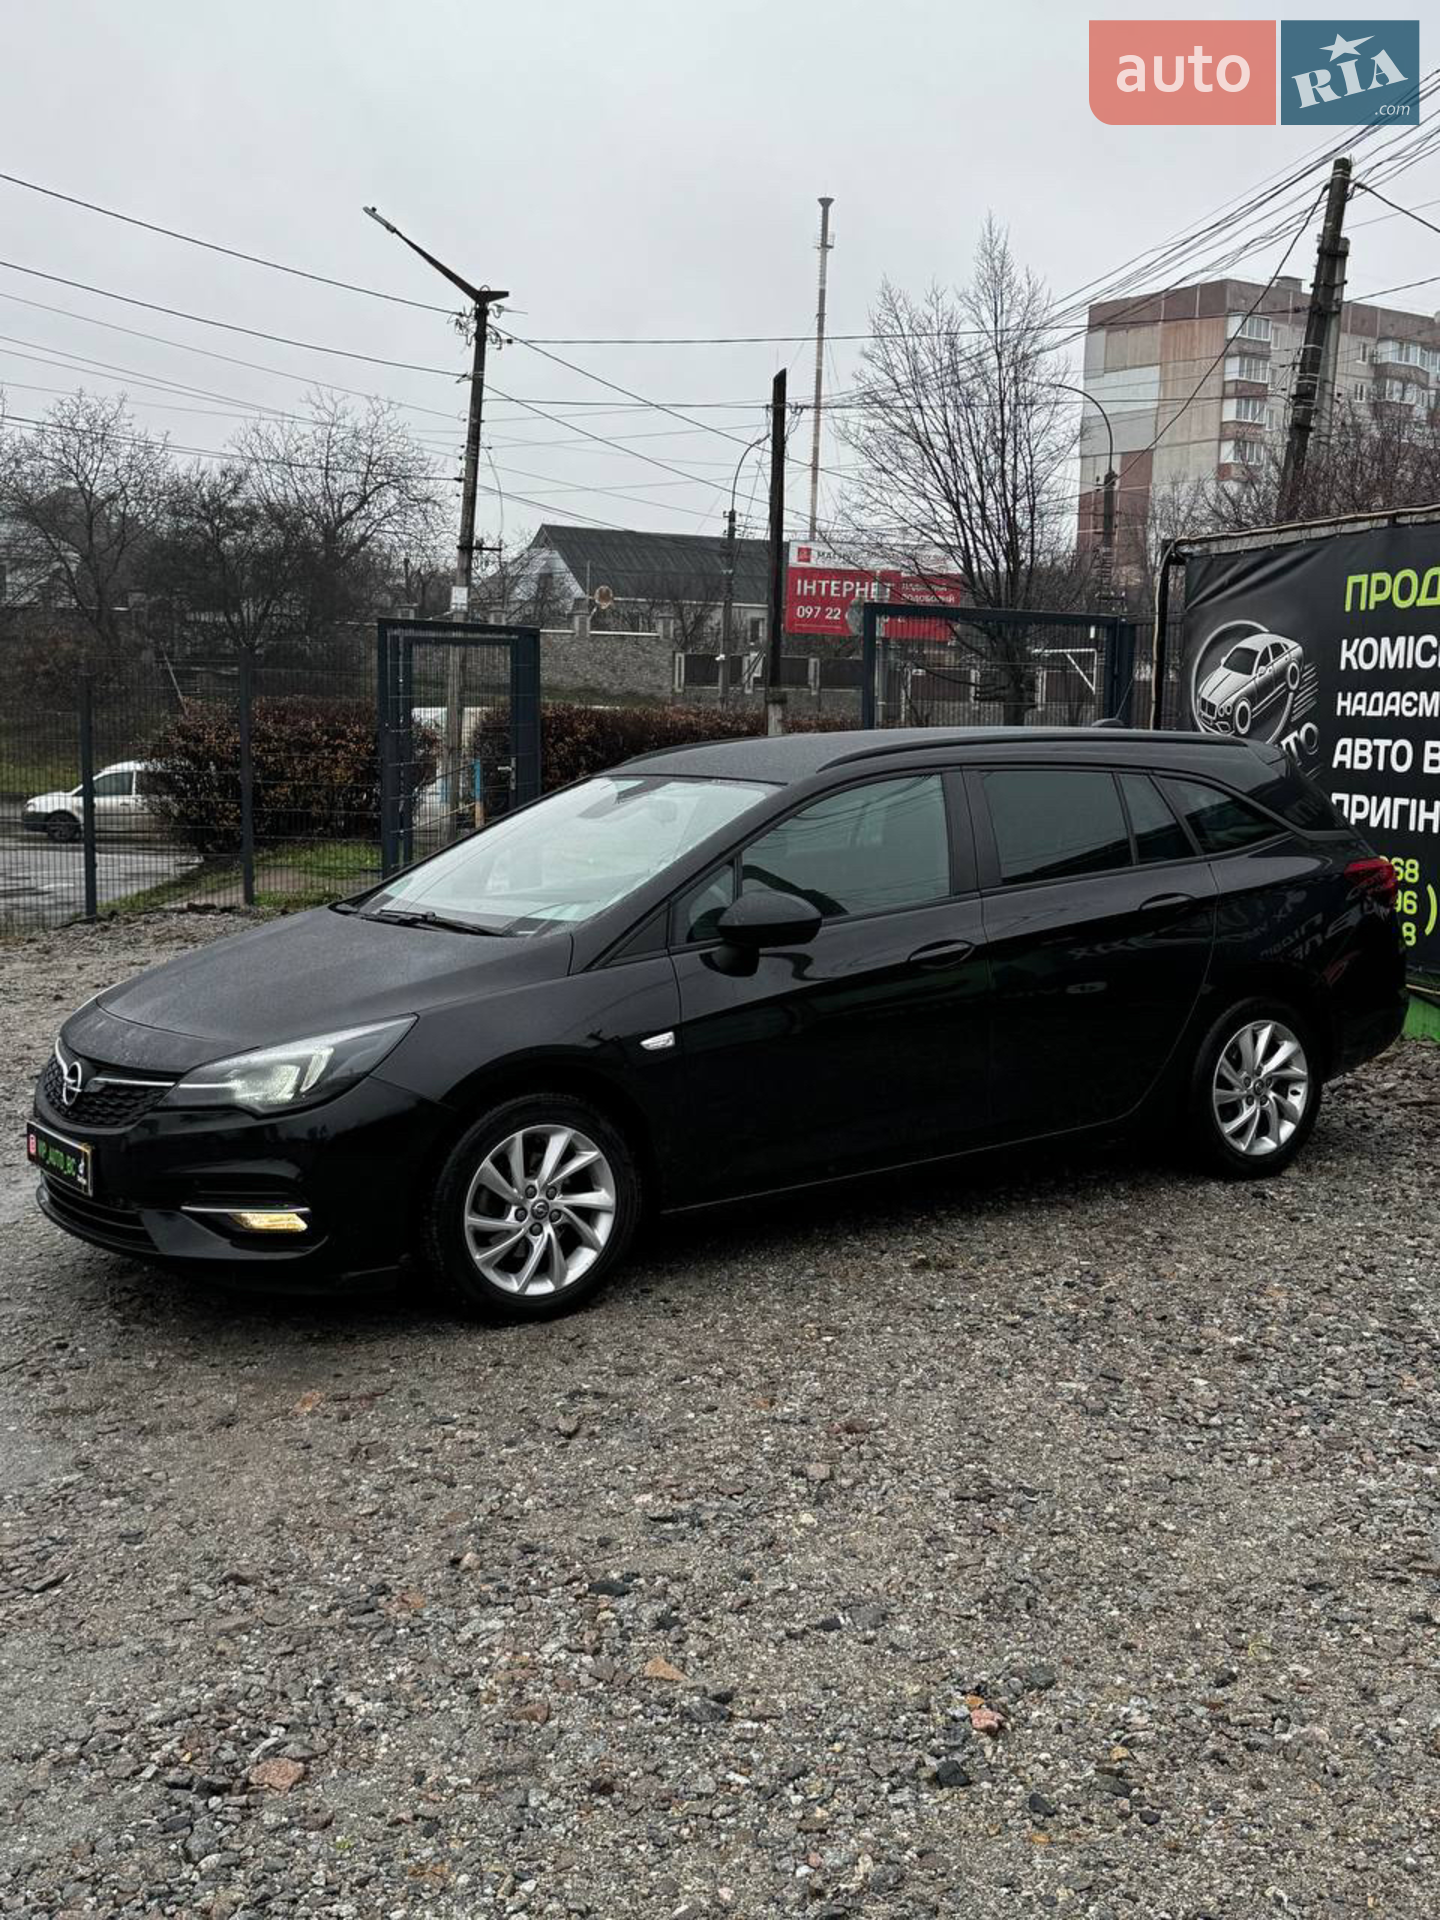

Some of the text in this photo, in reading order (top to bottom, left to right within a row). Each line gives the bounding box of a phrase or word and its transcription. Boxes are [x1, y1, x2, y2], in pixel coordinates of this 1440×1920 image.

[797, 579, 895, 602] ІНТЕРНЕТ
[1344, 566, 1440, 612] ПРОД
[797, 605, 821, 619] 097
[825, 607, 841, 620] 22
[1340, 634, 1440, 671] КОМІС
[1332, 738, 1413, 774] АВТО
[1380, 855, 1419, 883] 68
